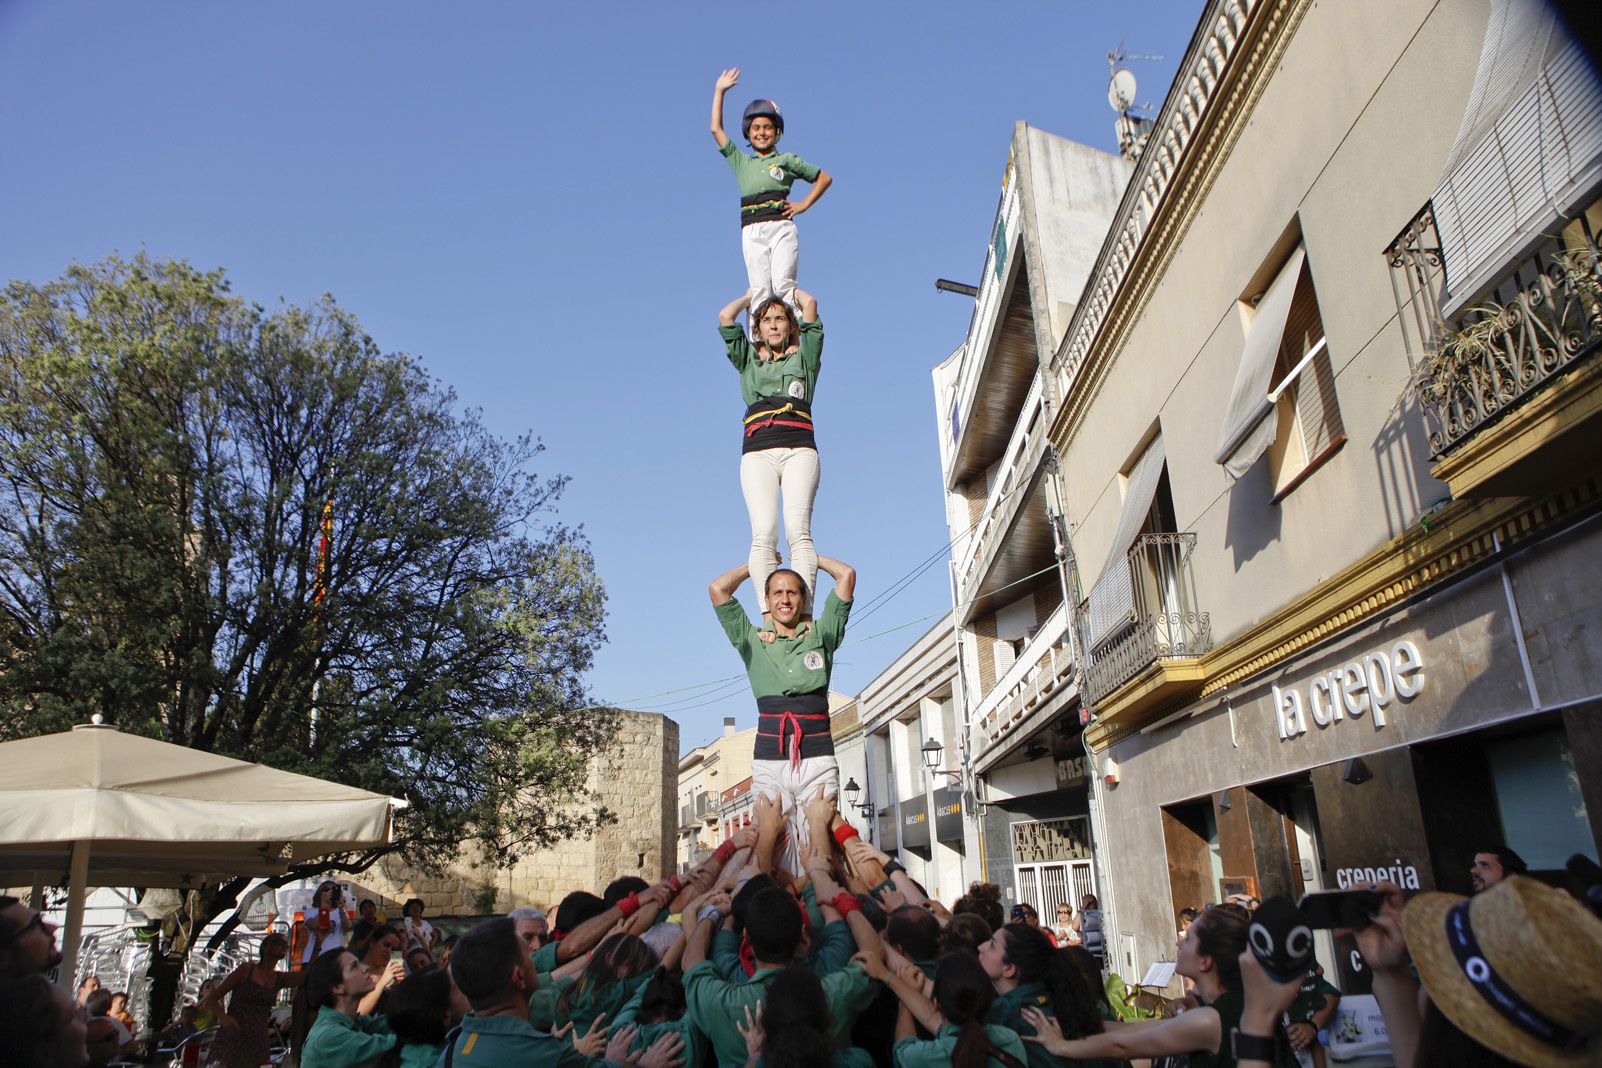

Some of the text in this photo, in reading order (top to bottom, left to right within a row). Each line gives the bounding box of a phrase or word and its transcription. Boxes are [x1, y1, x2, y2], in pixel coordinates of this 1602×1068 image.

[1271, 640, 1425, 739] la crepe
[1336, 858, 1420, 890] creperia
